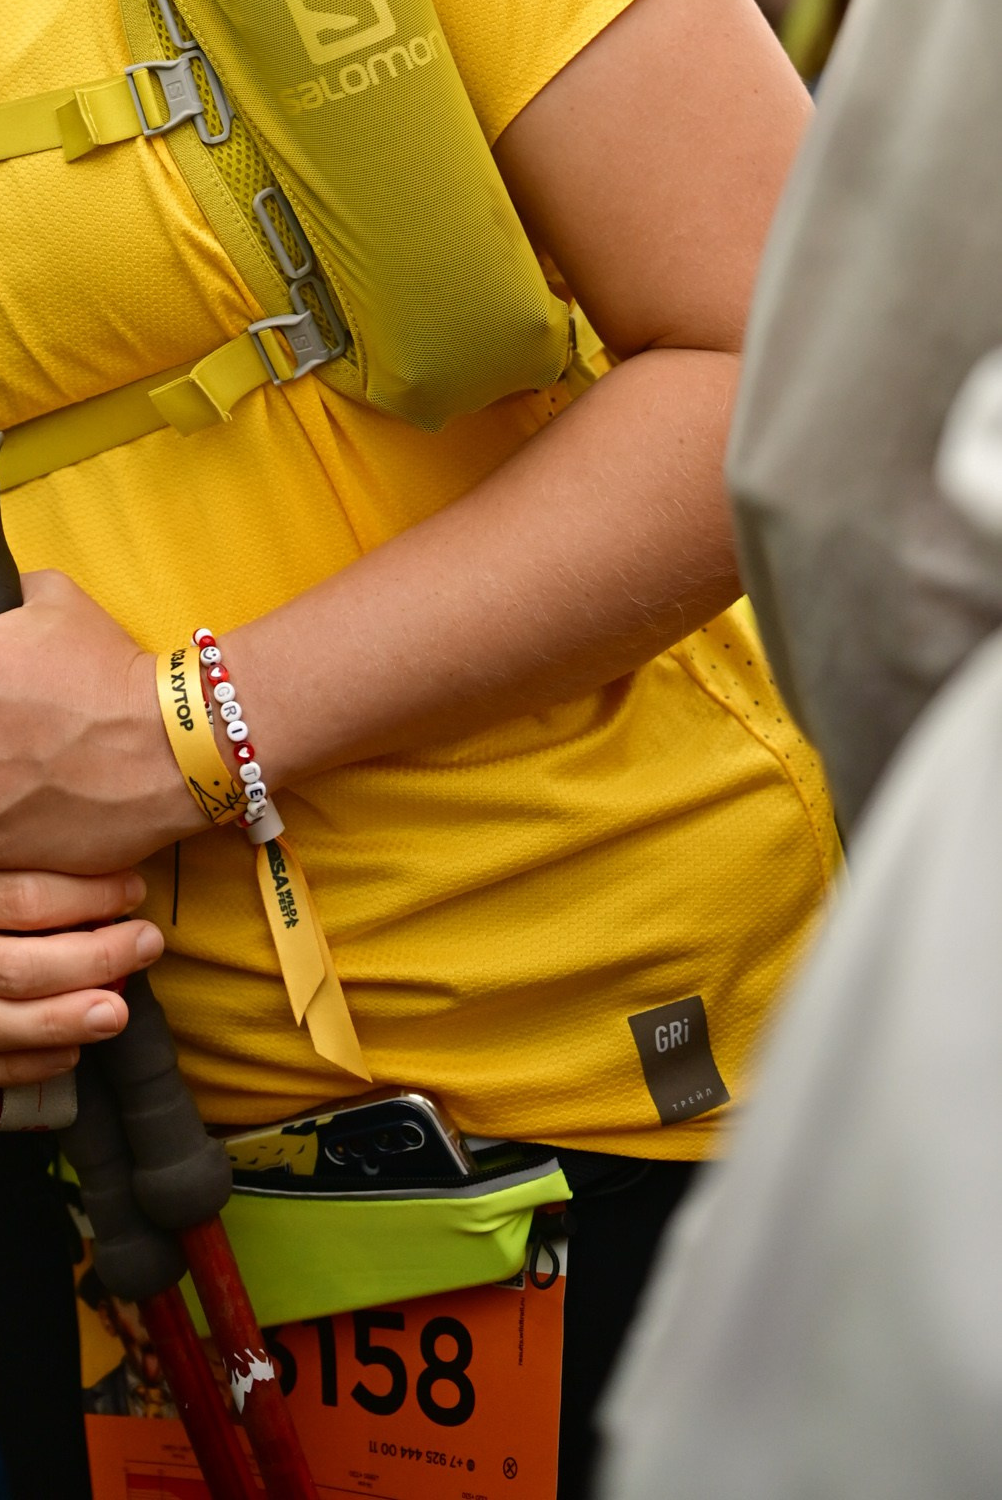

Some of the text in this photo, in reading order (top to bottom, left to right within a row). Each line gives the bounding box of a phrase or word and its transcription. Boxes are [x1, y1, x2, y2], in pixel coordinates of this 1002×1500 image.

[170, 647, 194, 731] ОЗА ХУТОР
[264, 839, 289, 891] OSA
[277, 891, 290, 917] FEST
[284, 888, 297, 917] WILD
[654, 1018, 689, 1053] GRi
[672, 1087, 713, 1112] ТРЕЙЛ
[368, 1440, 464, 1469] +7 925 444 00 11
